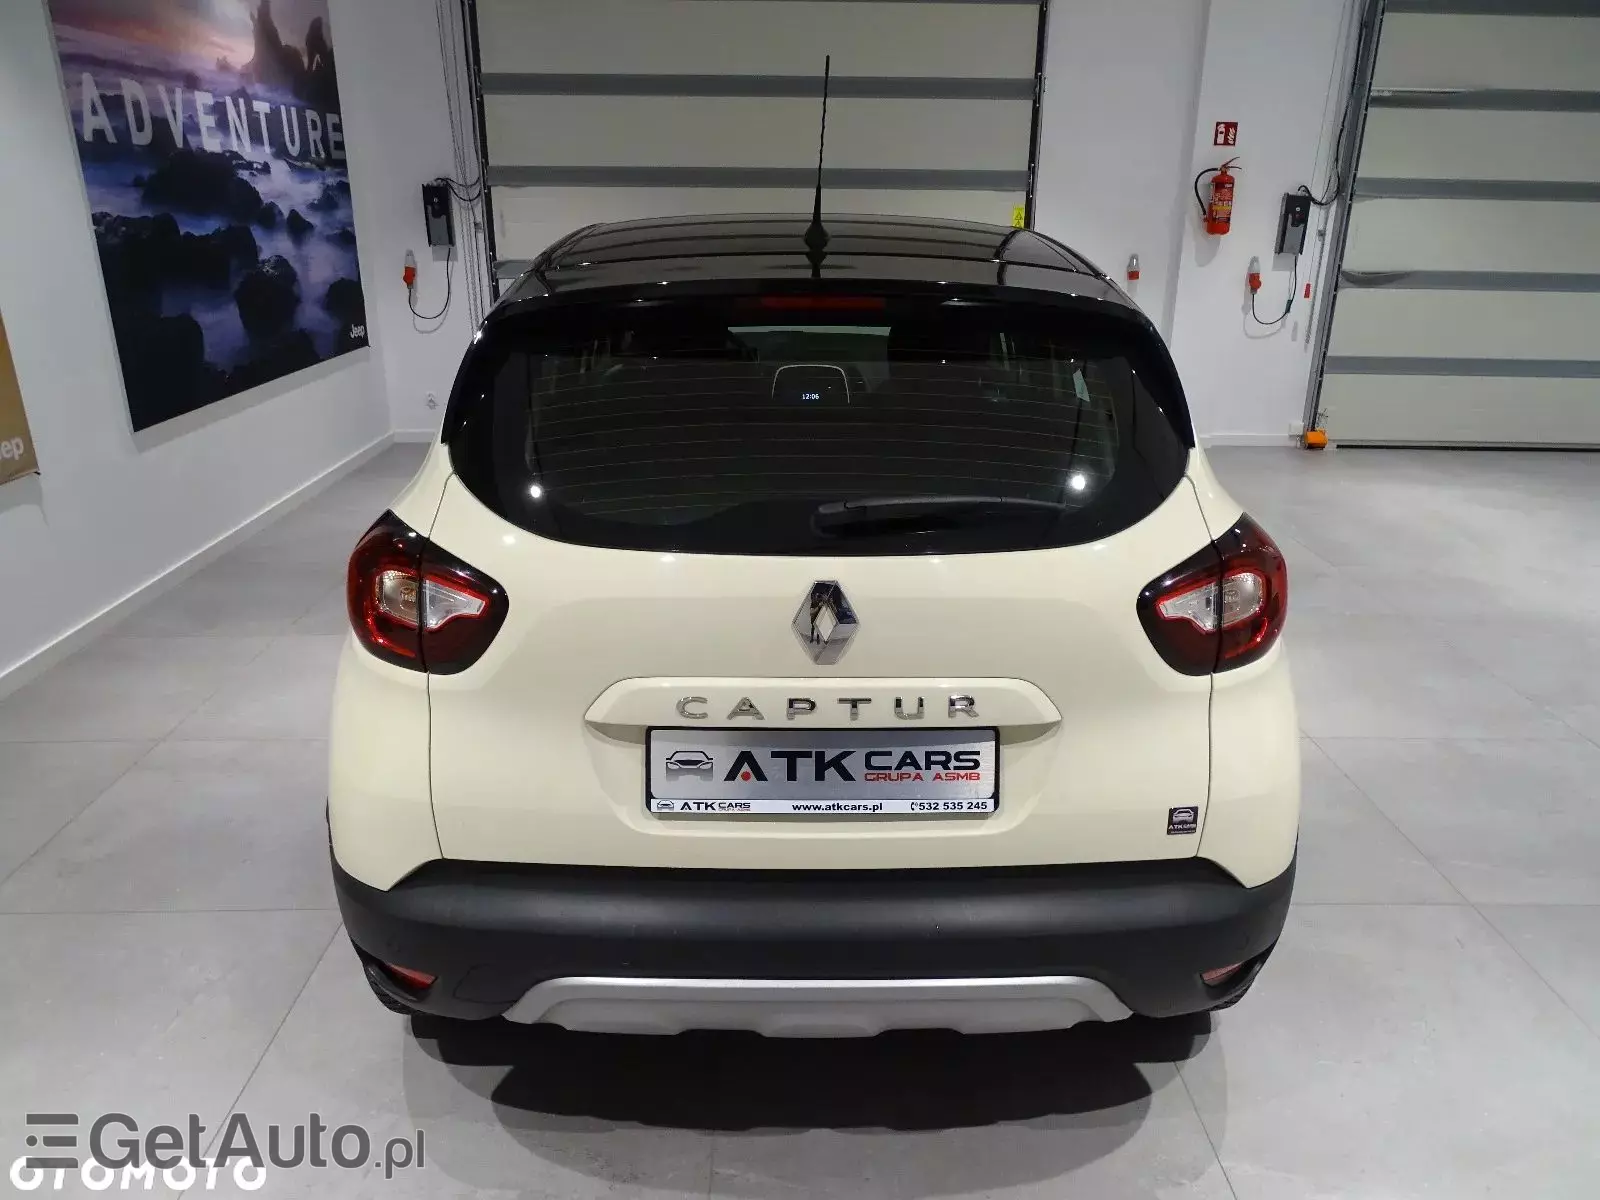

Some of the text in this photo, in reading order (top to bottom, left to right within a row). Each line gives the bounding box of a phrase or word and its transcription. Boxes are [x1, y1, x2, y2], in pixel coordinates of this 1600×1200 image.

[81, 72, 345, 160] ADVENTURE
[350, 324, 365, 339] Jeep
[0, 437, 24, 460] ep
[675, 696, 980, 721] CAPTUR
[723, 750, 981, 782] ATK CARS
[864, 772, 981, 782] GRUPA ASMB
[680, 801, 716, 811] ATK
[792, 802, 883, 812] www.atkcars.pl
[919, 801, 987, 810] 532 535 245
